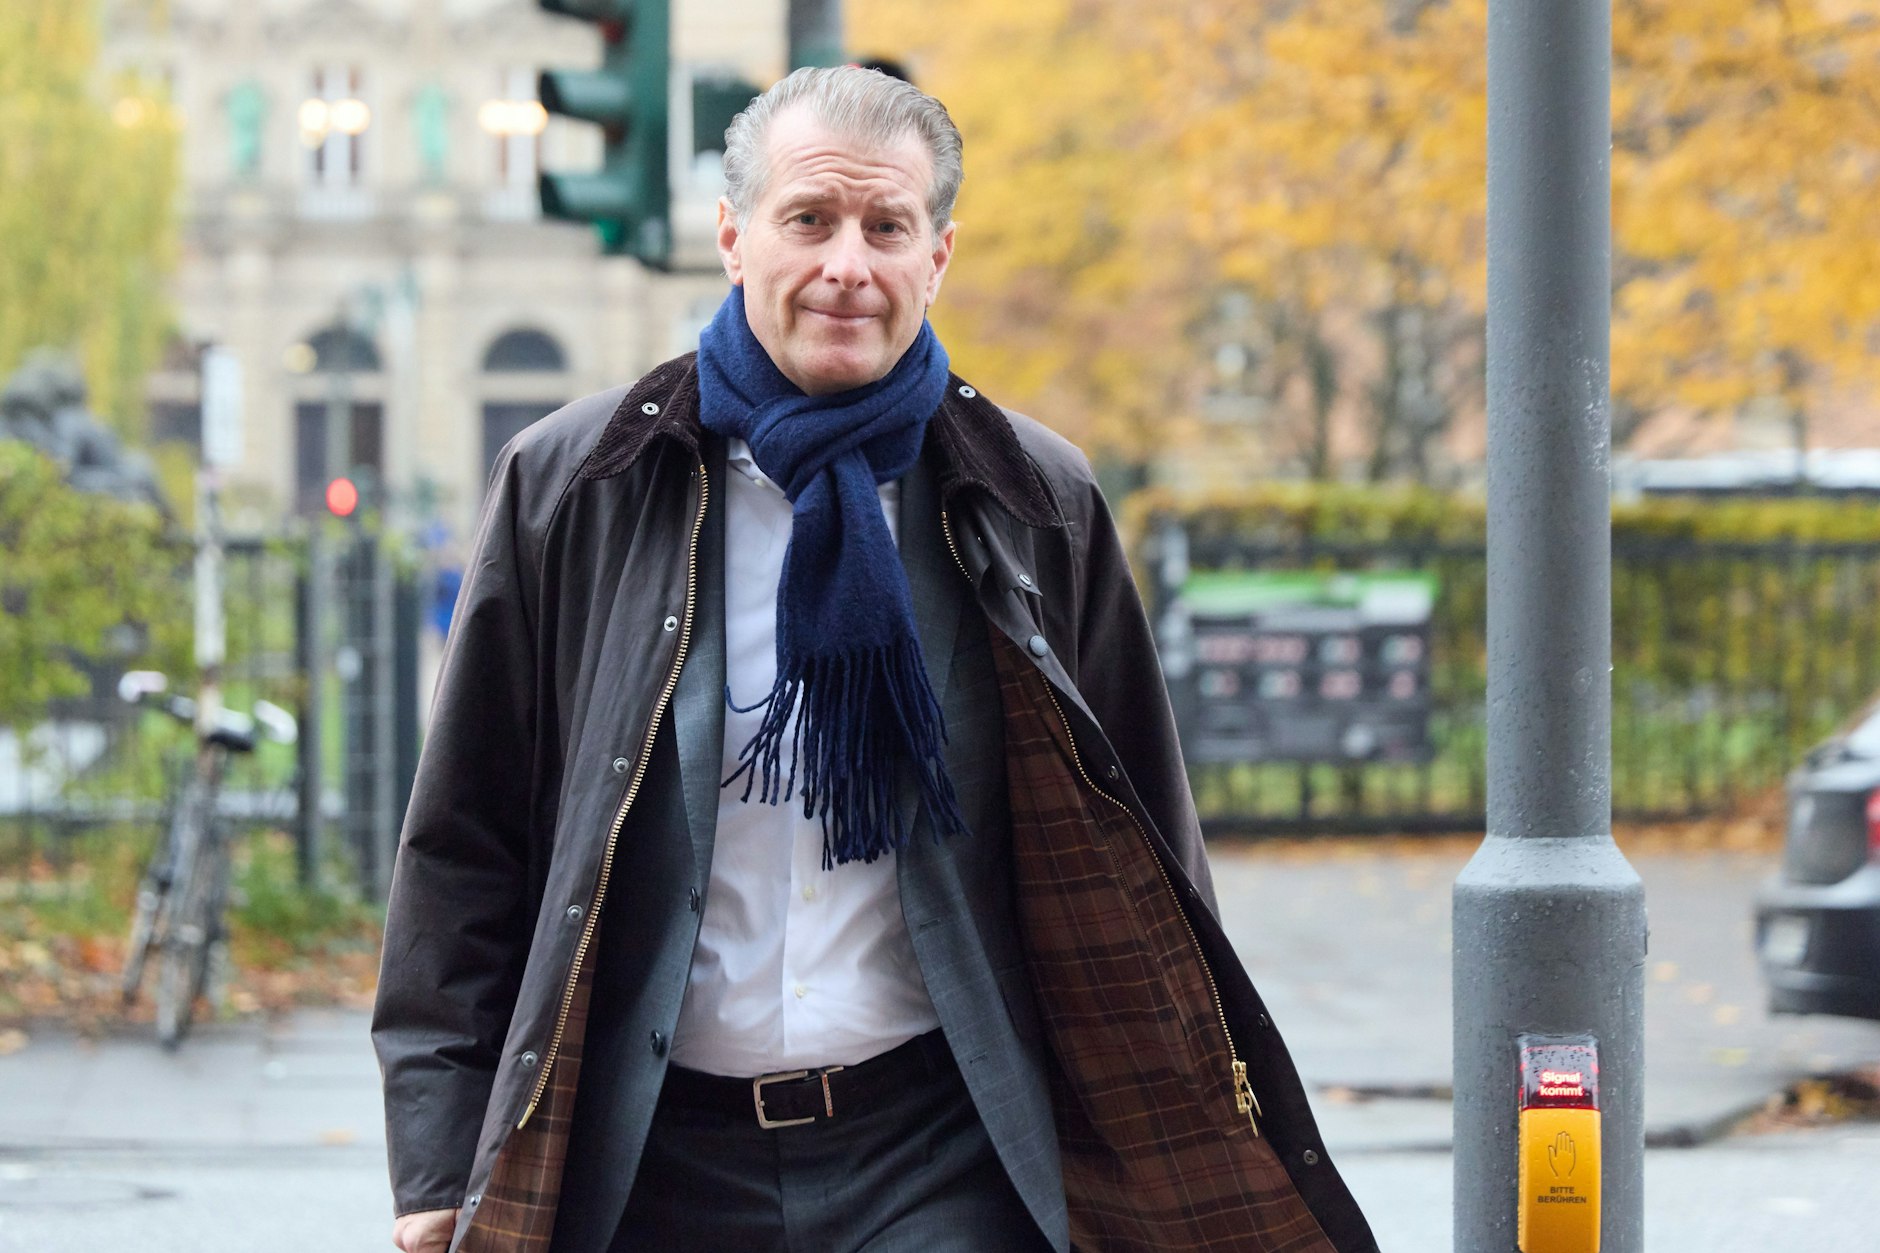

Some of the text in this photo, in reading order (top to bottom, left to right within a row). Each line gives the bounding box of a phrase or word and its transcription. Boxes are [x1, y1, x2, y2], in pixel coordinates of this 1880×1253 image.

[1541, 1071, 1581, 1084] Signal
[1540, 1085, 1583, 1096] kommt
[1550, 1186, 1575, 1194] BITTE
[1537, 1194, 1587, 1203] BERÜHREN
